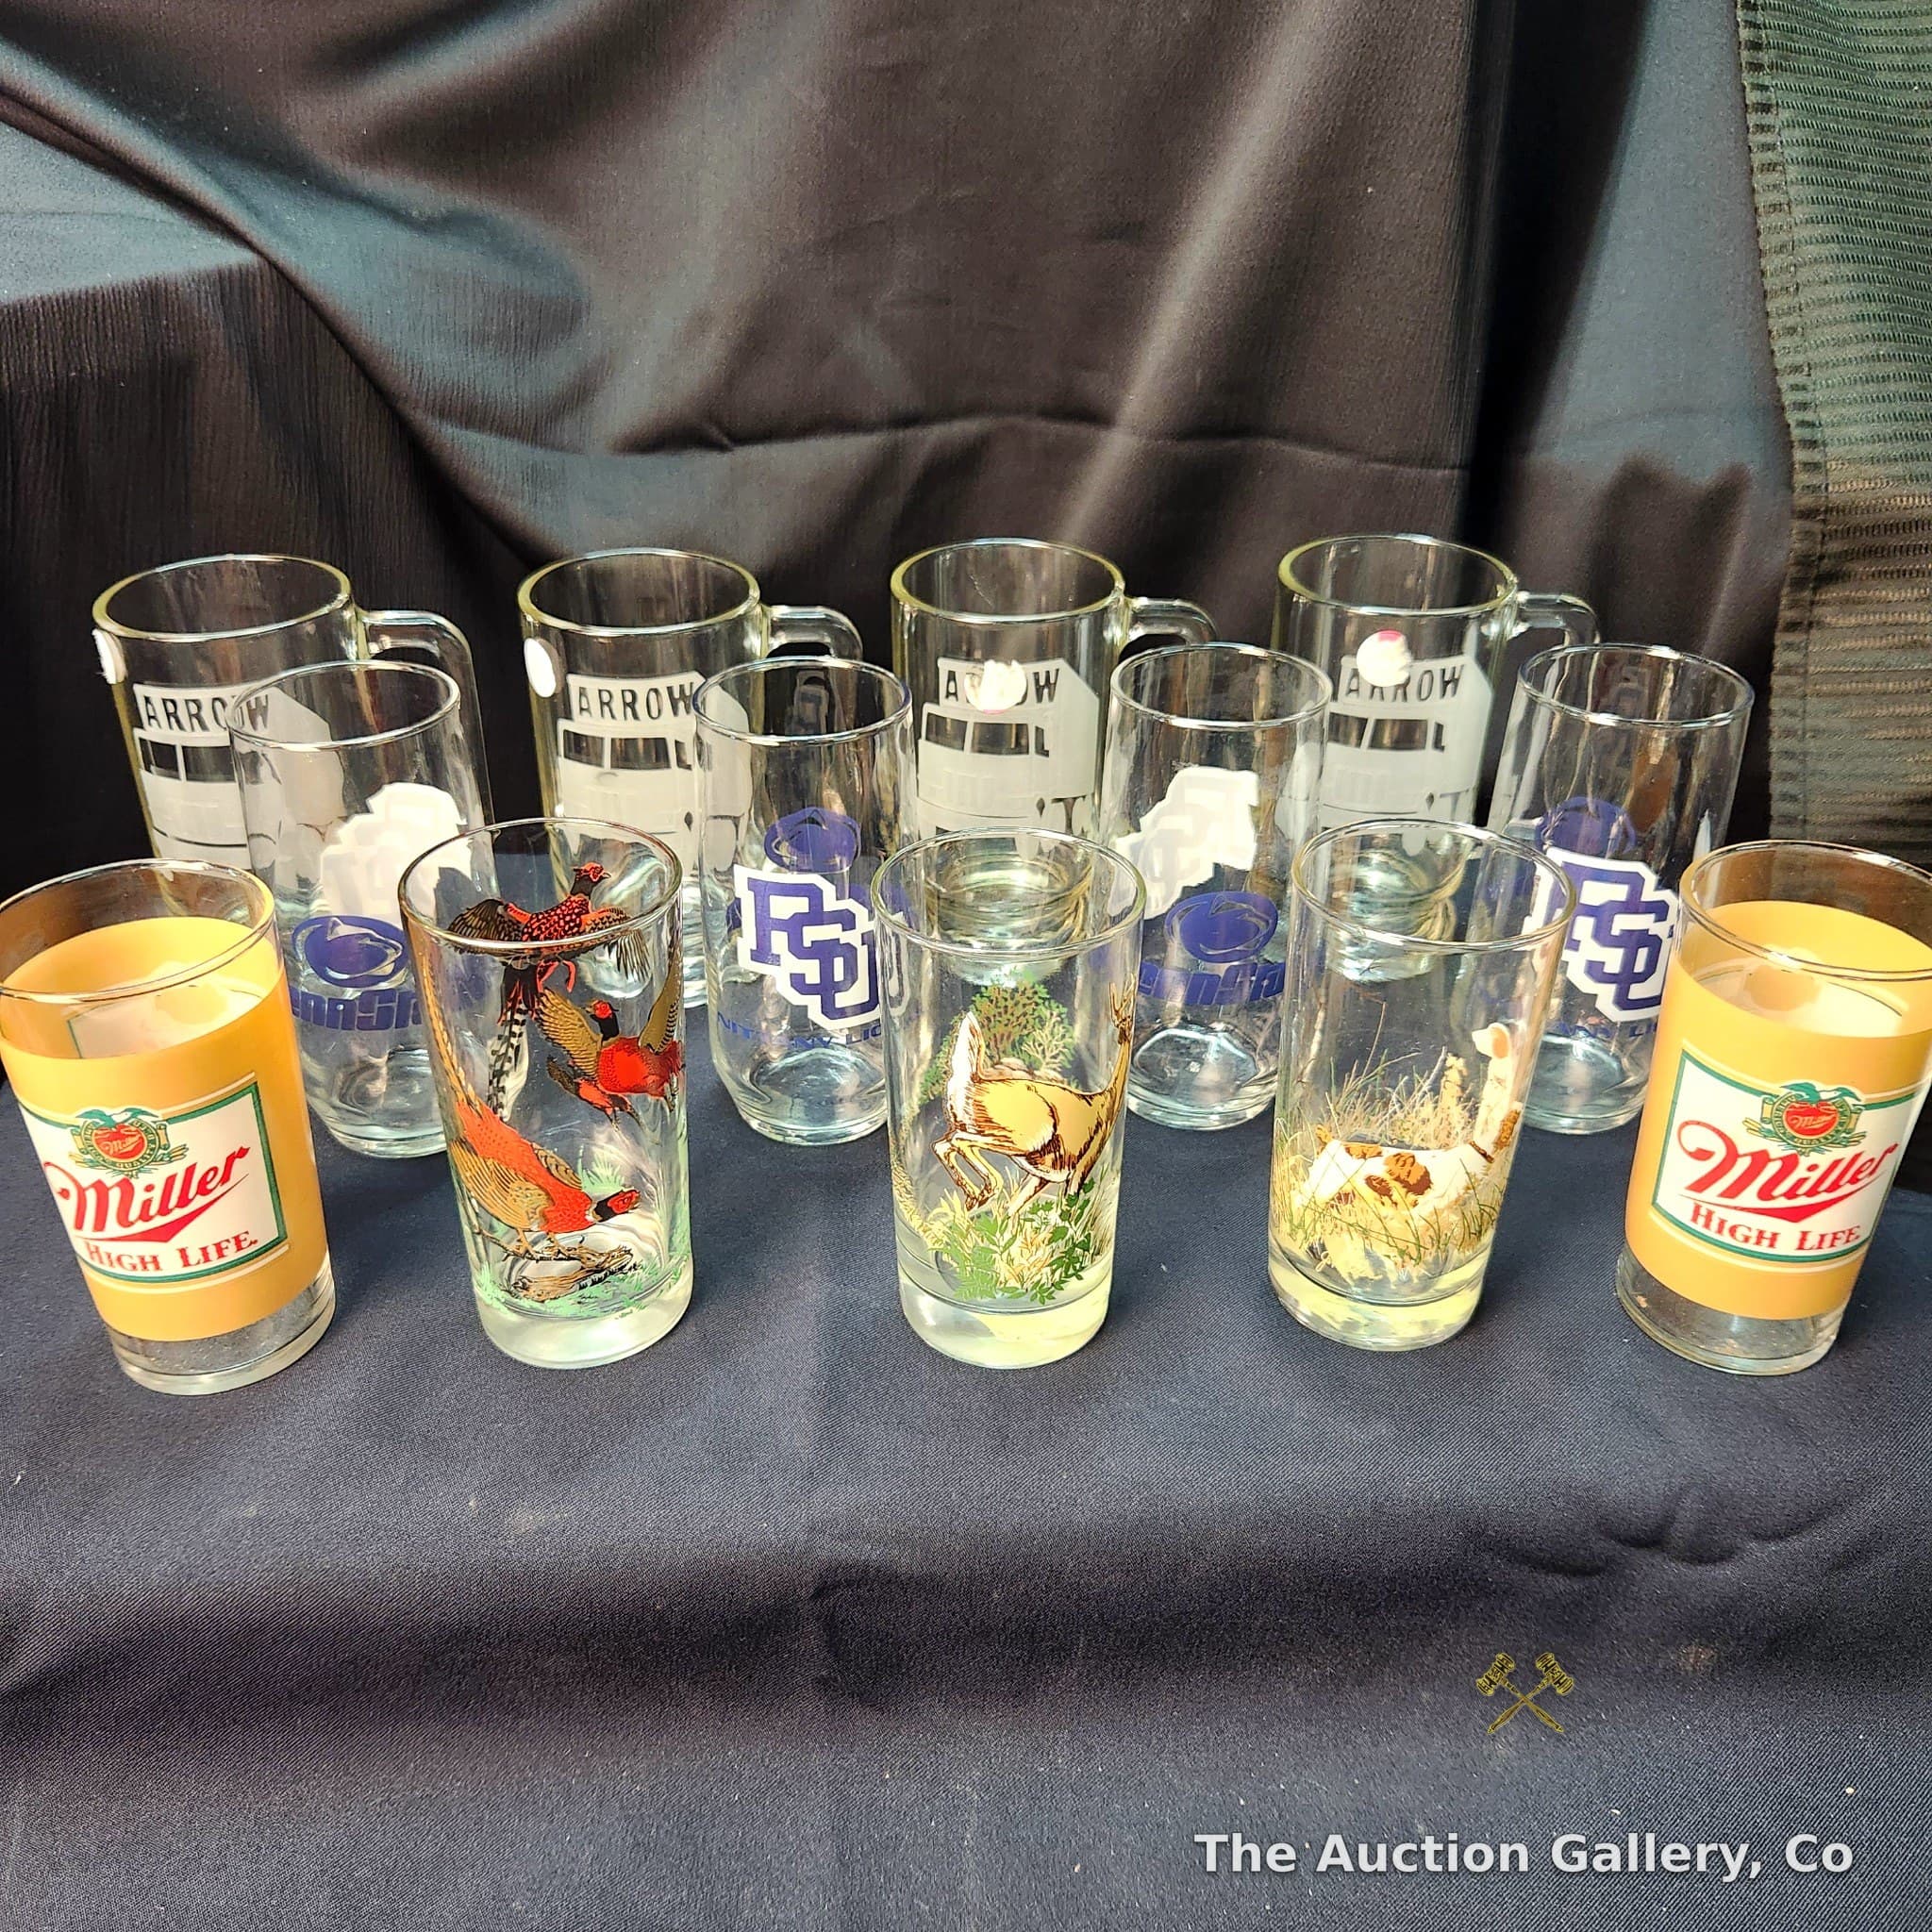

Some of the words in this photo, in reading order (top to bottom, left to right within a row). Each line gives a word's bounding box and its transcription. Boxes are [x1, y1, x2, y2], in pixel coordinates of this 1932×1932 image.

[143, 693, 269, 732] ARROW
[578, 681, 693, 721] ARROW
[1677, 1120, 1899, 1201] Miller
[43, 1145, 251, 1233] Miller
[1690, 1203, 1781, 1249] HIGH
[84, 1241, 162, 1272] HIGH
